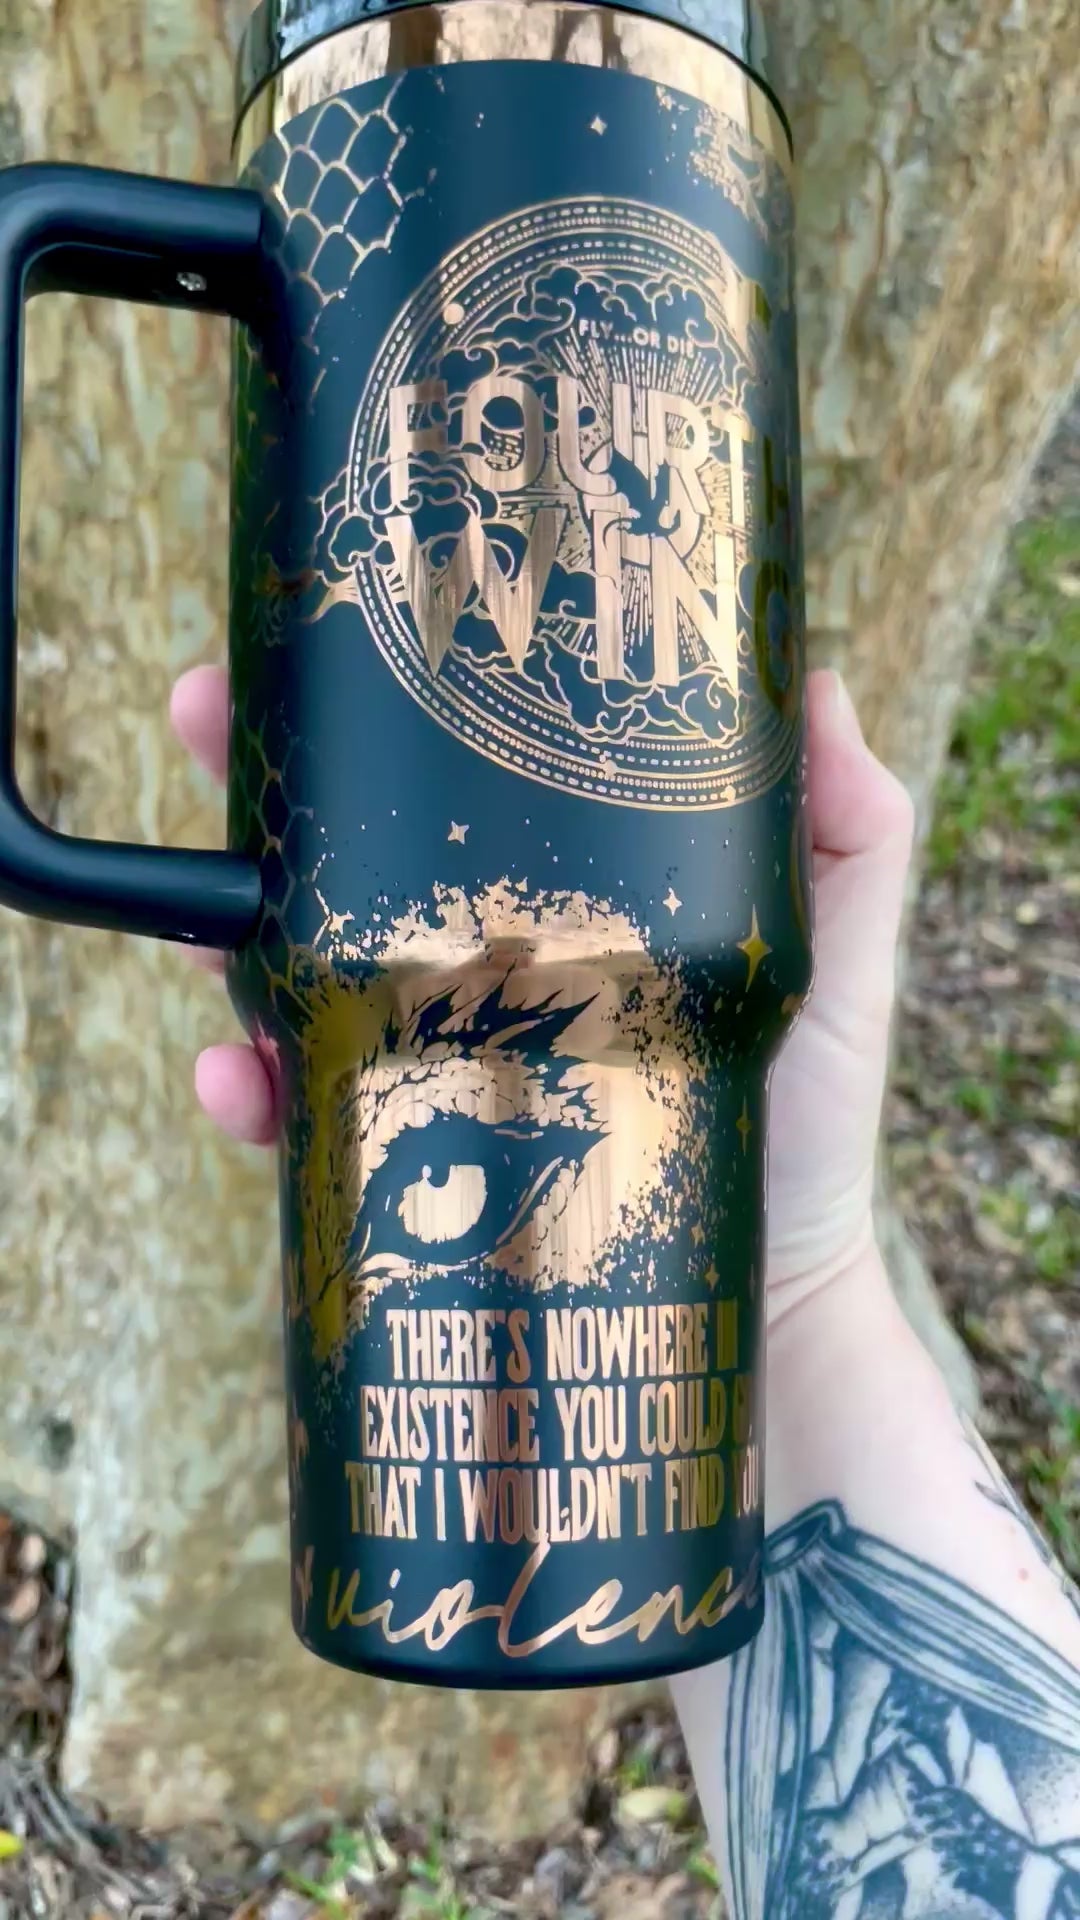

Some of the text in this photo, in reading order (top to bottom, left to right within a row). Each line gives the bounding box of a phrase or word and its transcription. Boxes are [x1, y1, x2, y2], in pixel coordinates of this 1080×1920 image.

[386, 1308, 531, 1384] THERE'S
[546, 1303, 708, 1381] NOWHERE
[360, 1385, 540, 1463] EXISTENCE
[555, 1385, 627, 1462] YOU
[639, 1377, 727, 1457] COULD
[344, 1461, 419, 1540] THAT
[434, 1467, 447, 1541] I
[458, 1462, 652, 1543] WOULDN'T
[664, 1453, 725, 1533] FIND
